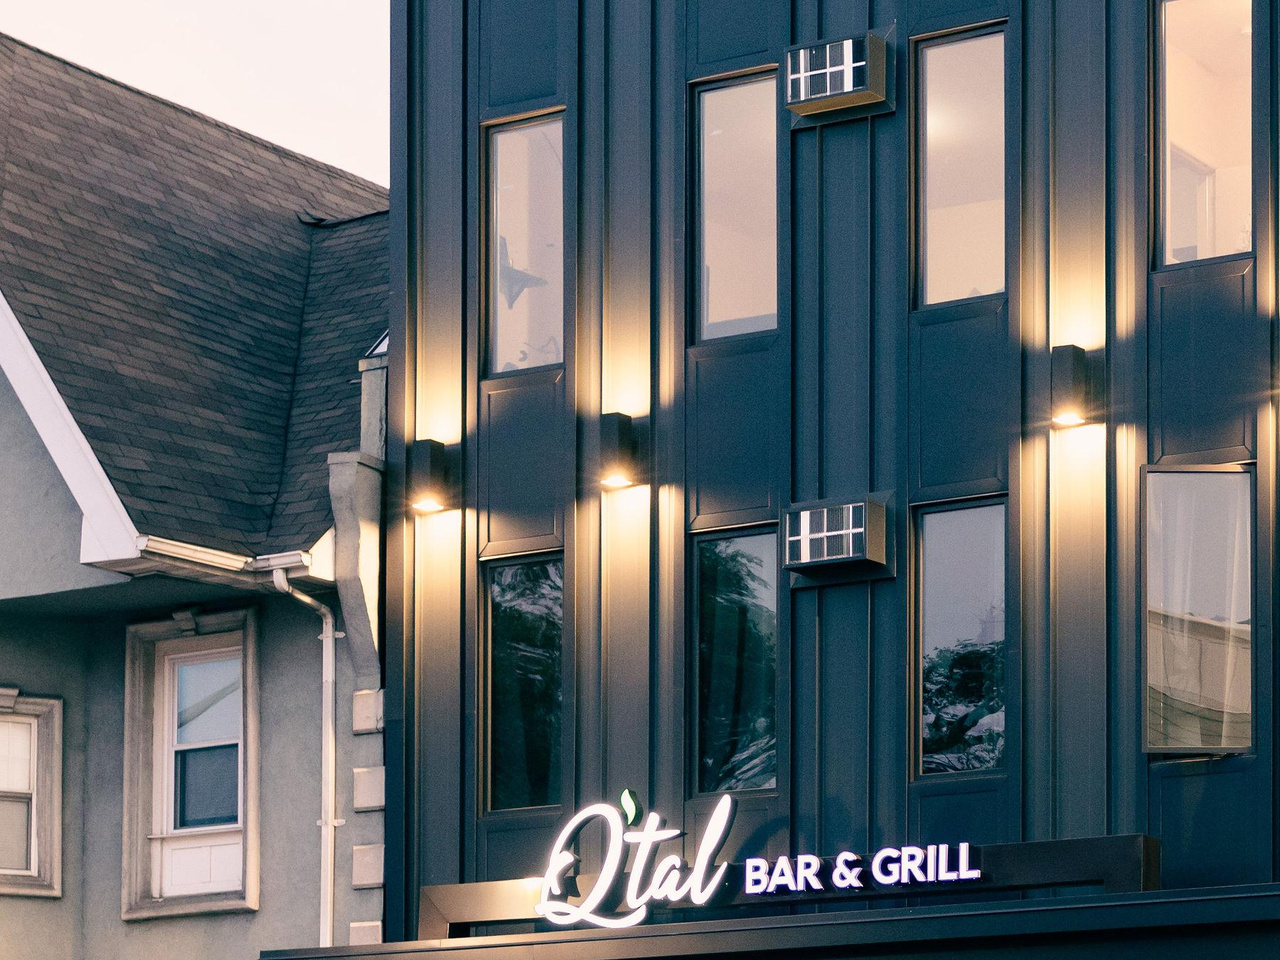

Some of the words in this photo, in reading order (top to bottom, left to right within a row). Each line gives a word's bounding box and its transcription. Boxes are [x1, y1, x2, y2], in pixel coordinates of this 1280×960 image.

[745, 854, 822, 893] BAR
[832, 851, 863, 887] &
[871, 842, 981, 885] GRILL
